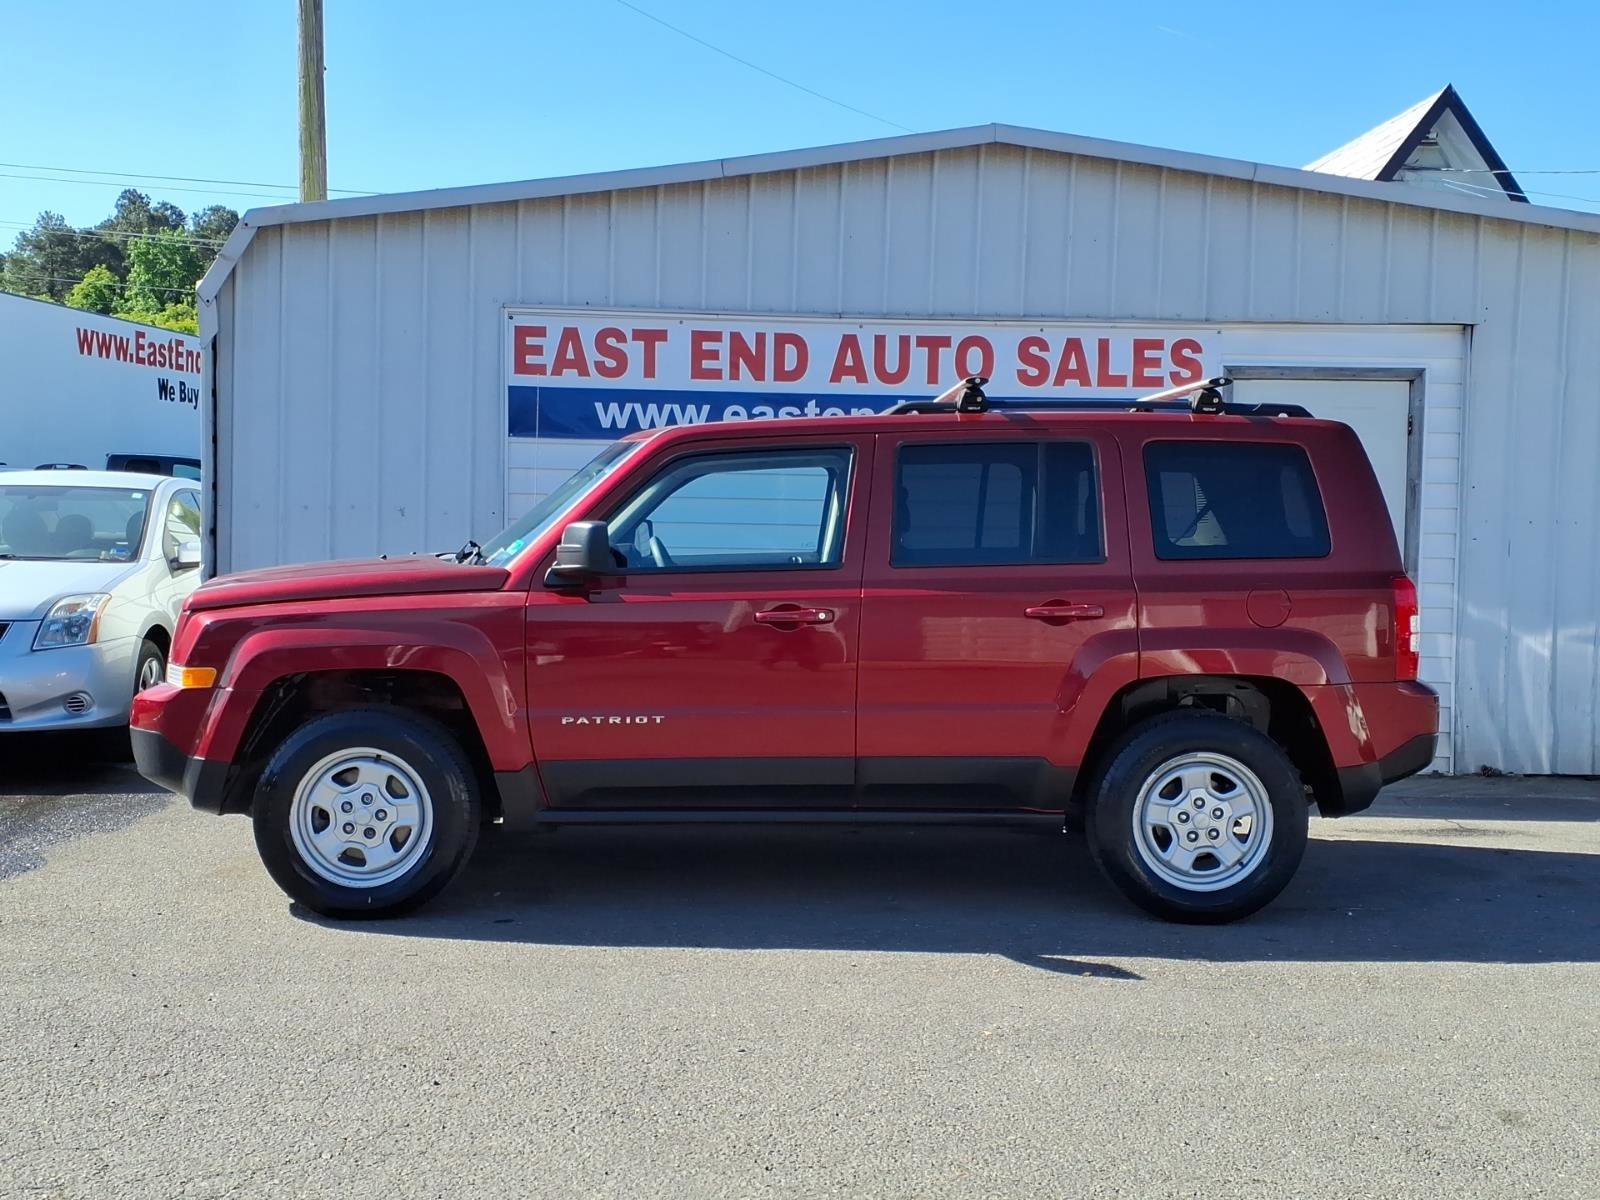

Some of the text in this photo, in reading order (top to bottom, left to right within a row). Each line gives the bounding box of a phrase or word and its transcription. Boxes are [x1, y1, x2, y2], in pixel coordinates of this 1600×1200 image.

[513, 325, 1204, 389] EAST END AUTO SALES
[158, 377, 200, 410] We Buy
[561, 715, 666, 725] PATRIOT
